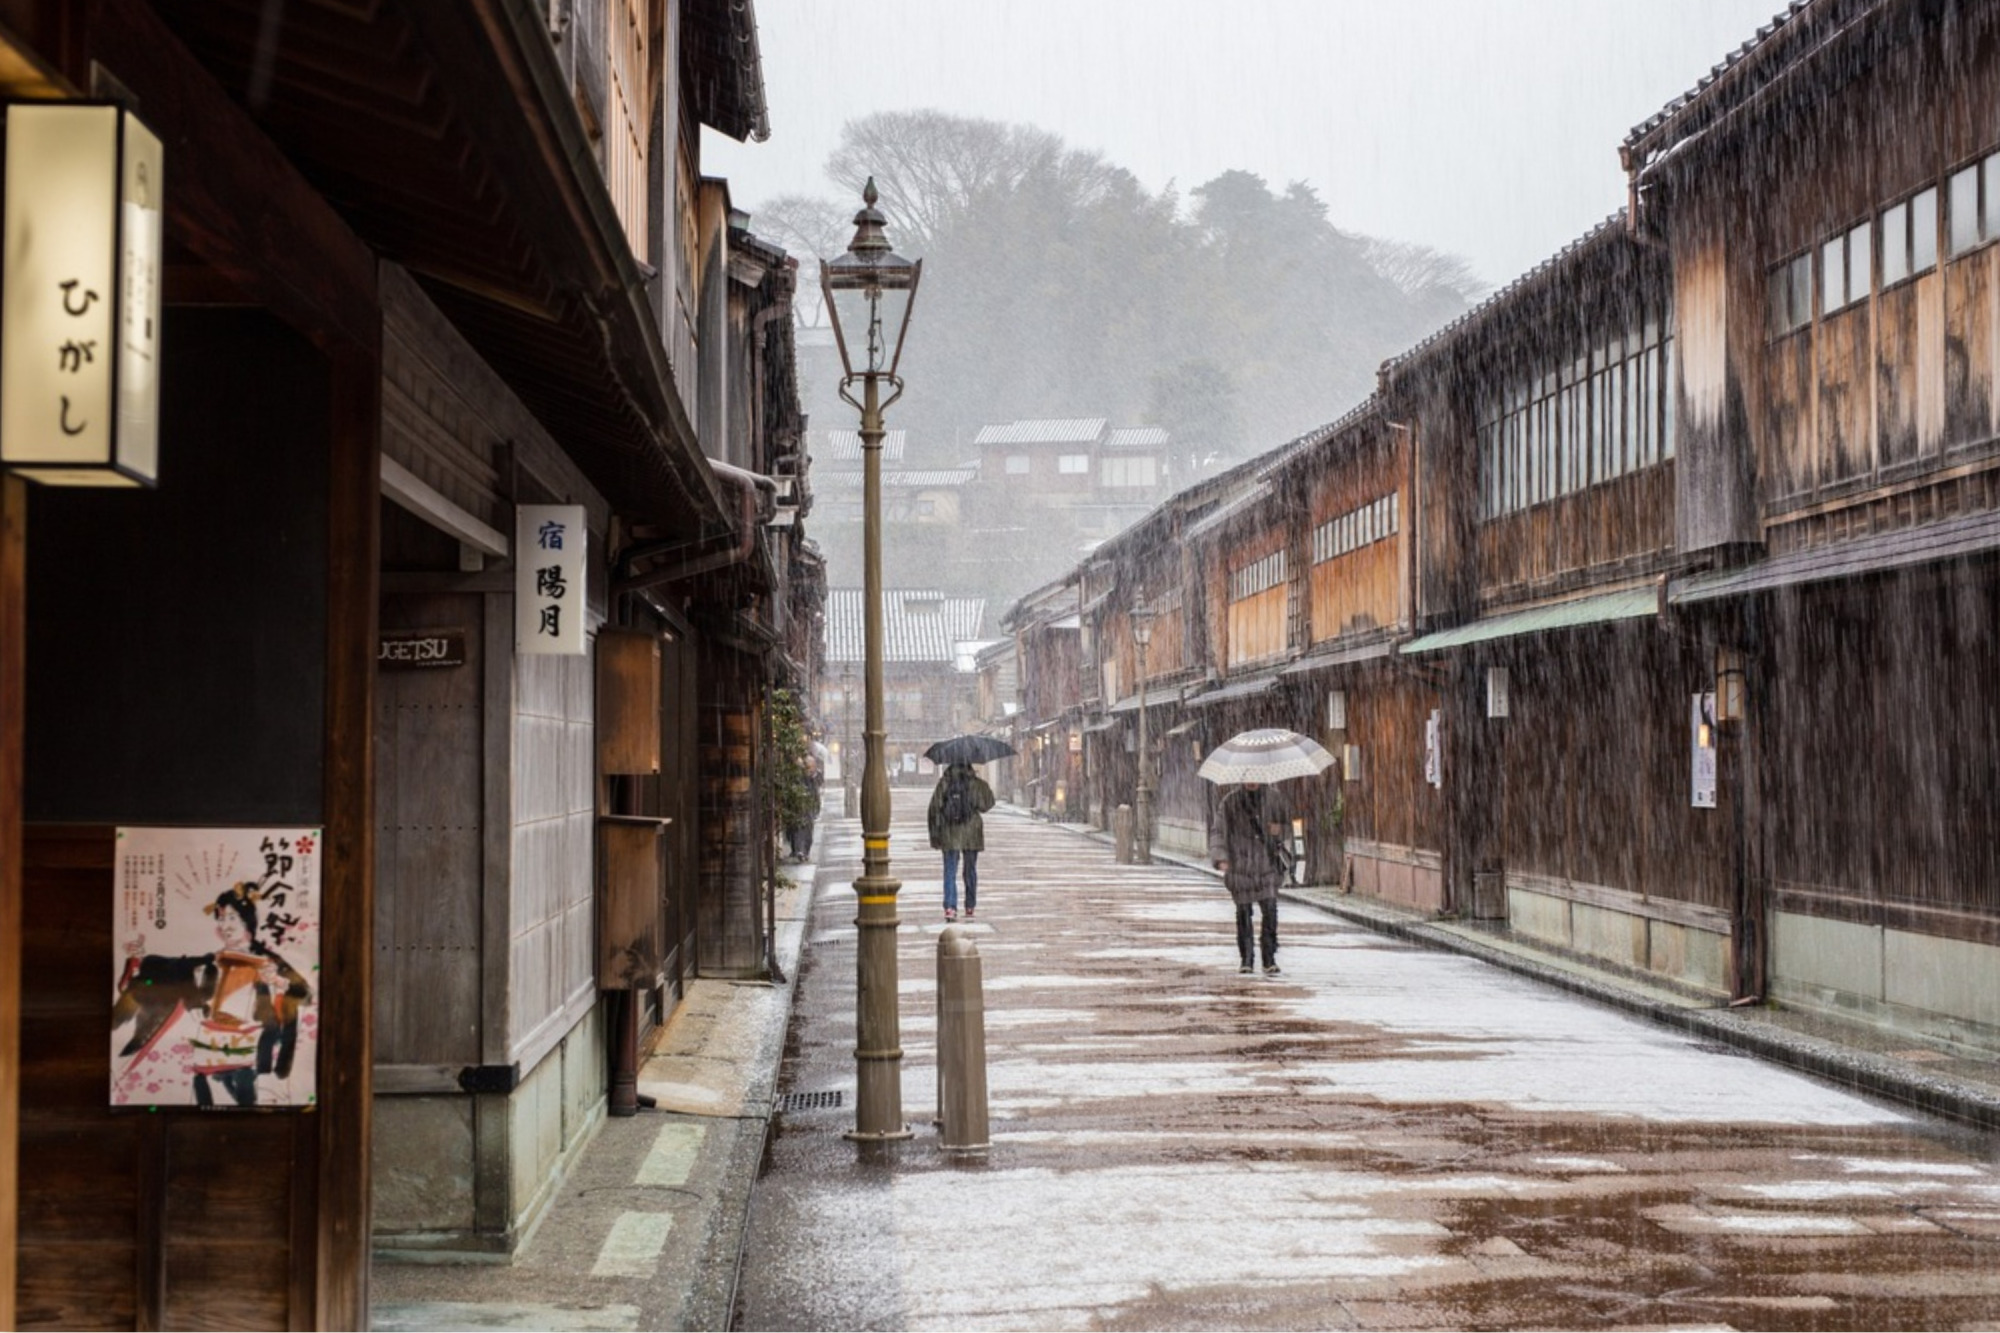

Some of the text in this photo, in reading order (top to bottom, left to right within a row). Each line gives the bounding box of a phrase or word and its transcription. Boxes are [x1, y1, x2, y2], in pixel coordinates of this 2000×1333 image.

[58, 279, 99, 436] ひがし
[536, 521, 567, 637] 宿 陽月
[259, 836, 301, 946] 節分祭
